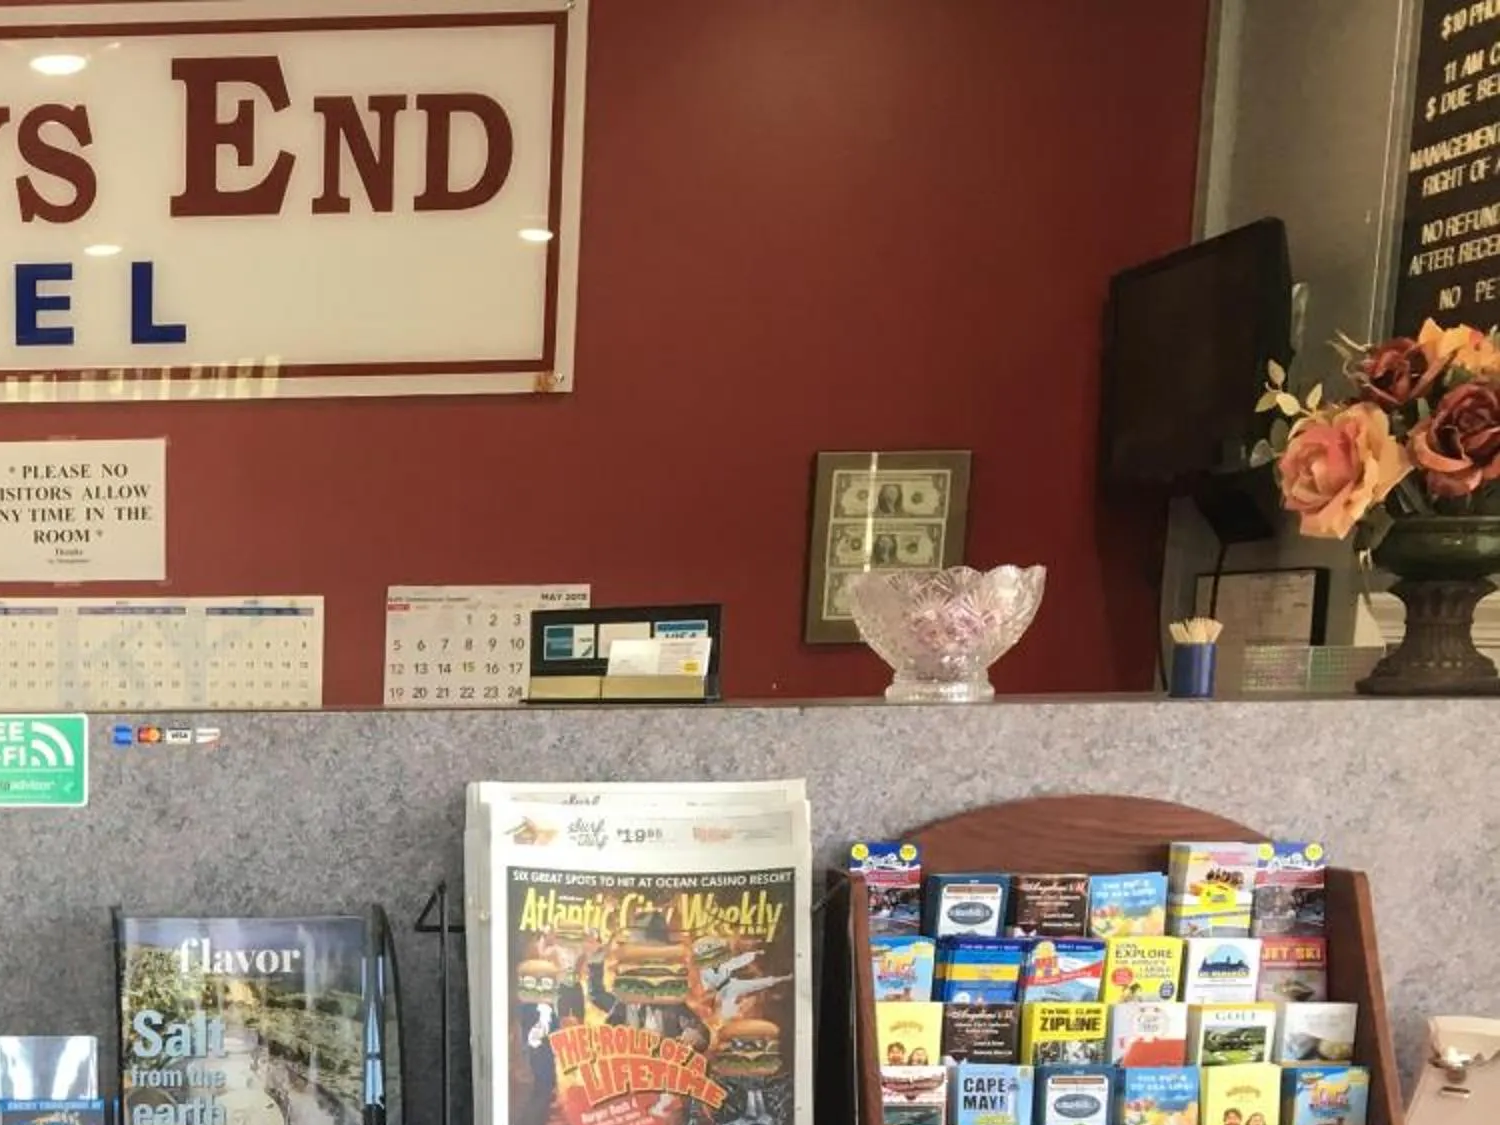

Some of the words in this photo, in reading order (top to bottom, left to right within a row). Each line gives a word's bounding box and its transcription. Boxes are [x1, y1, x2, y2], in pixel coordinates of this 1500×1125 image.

[1460, 49, 1485, 79] AM
[1440, 84, 1473, 115] DUE
[170, 56, 513, 217] END
[1422, 164, 1467, 198] RIGHT
[1421, 219, 1443, 246] NO
[1408, 247, 1455, 277] AFTER
[1438, 285, 1462, 311] NO
[22, 464, 91, 479] PLEASE
[101, 464, 128, 479] NO
[83, 485, 151, 500] ALLOW
[28, 508, 75, 522] TIME
[85, 507, 105, 521] IN
[114, 507, 152, 521] THE
[33, 529, 91, 543] ROOM
[466, 614, 472, 625] 1
[489, 614, 498, 626] 2
[513, 614, 522, 626] 3
[393, 640, 402, 651] 5
[417, 640, 426, 651] 6
[441, 639, 449, 651] 7
[465, 638, 473, 650] 8
[488, 638, 497, 651] 9
[510, 638, 525, 650] 10
[391, 664, 404, 675] 12
[415, 662, 428, 674] 13
[438, 663, 452, 674] 14
[462, 661, 475, 672] 15
[485, 663, 500, 674] 16
[509, 662, 523, 673] 17
[390, 687, 404, 699] 19
[412, 687, 428, 698] 20
[435, 687, 449, 698] 21
[460, 687, 475, 698] 22
[484, 687, 499, 698] 23
[508, 687, 523, 698] 24
[512, 870, 529, 881] SIX
[532, 872, 564, 884] GREAT
[565, 873, 597, 887] SPOTS
[599, 875, 614, 887] TO
[617, 876, 635, 887] HIT
[637, 876, 653, 888] AT
[655, 876, 699, 888] OCEAN
[701, 875, 747, 887] CASINO
[750, 872, 792, 885] RESORT
[178, 936, 301, 974] flavor
[133, 1009, 227, 1057] Salt
[1040, 1017, 1100, 1031] ZIPLINE
[550, 1026, 591, 1072] THE
[660, 1037, 688, 1063] OF
[690, 1052, 708, 1077] A
[131, 1066, 182, 1087] from
[187, 1064, 227, 1087] the
[579, 1056, 729, 1108] LIFETIME
[963, 1078, 1005, 1093] CAPE
